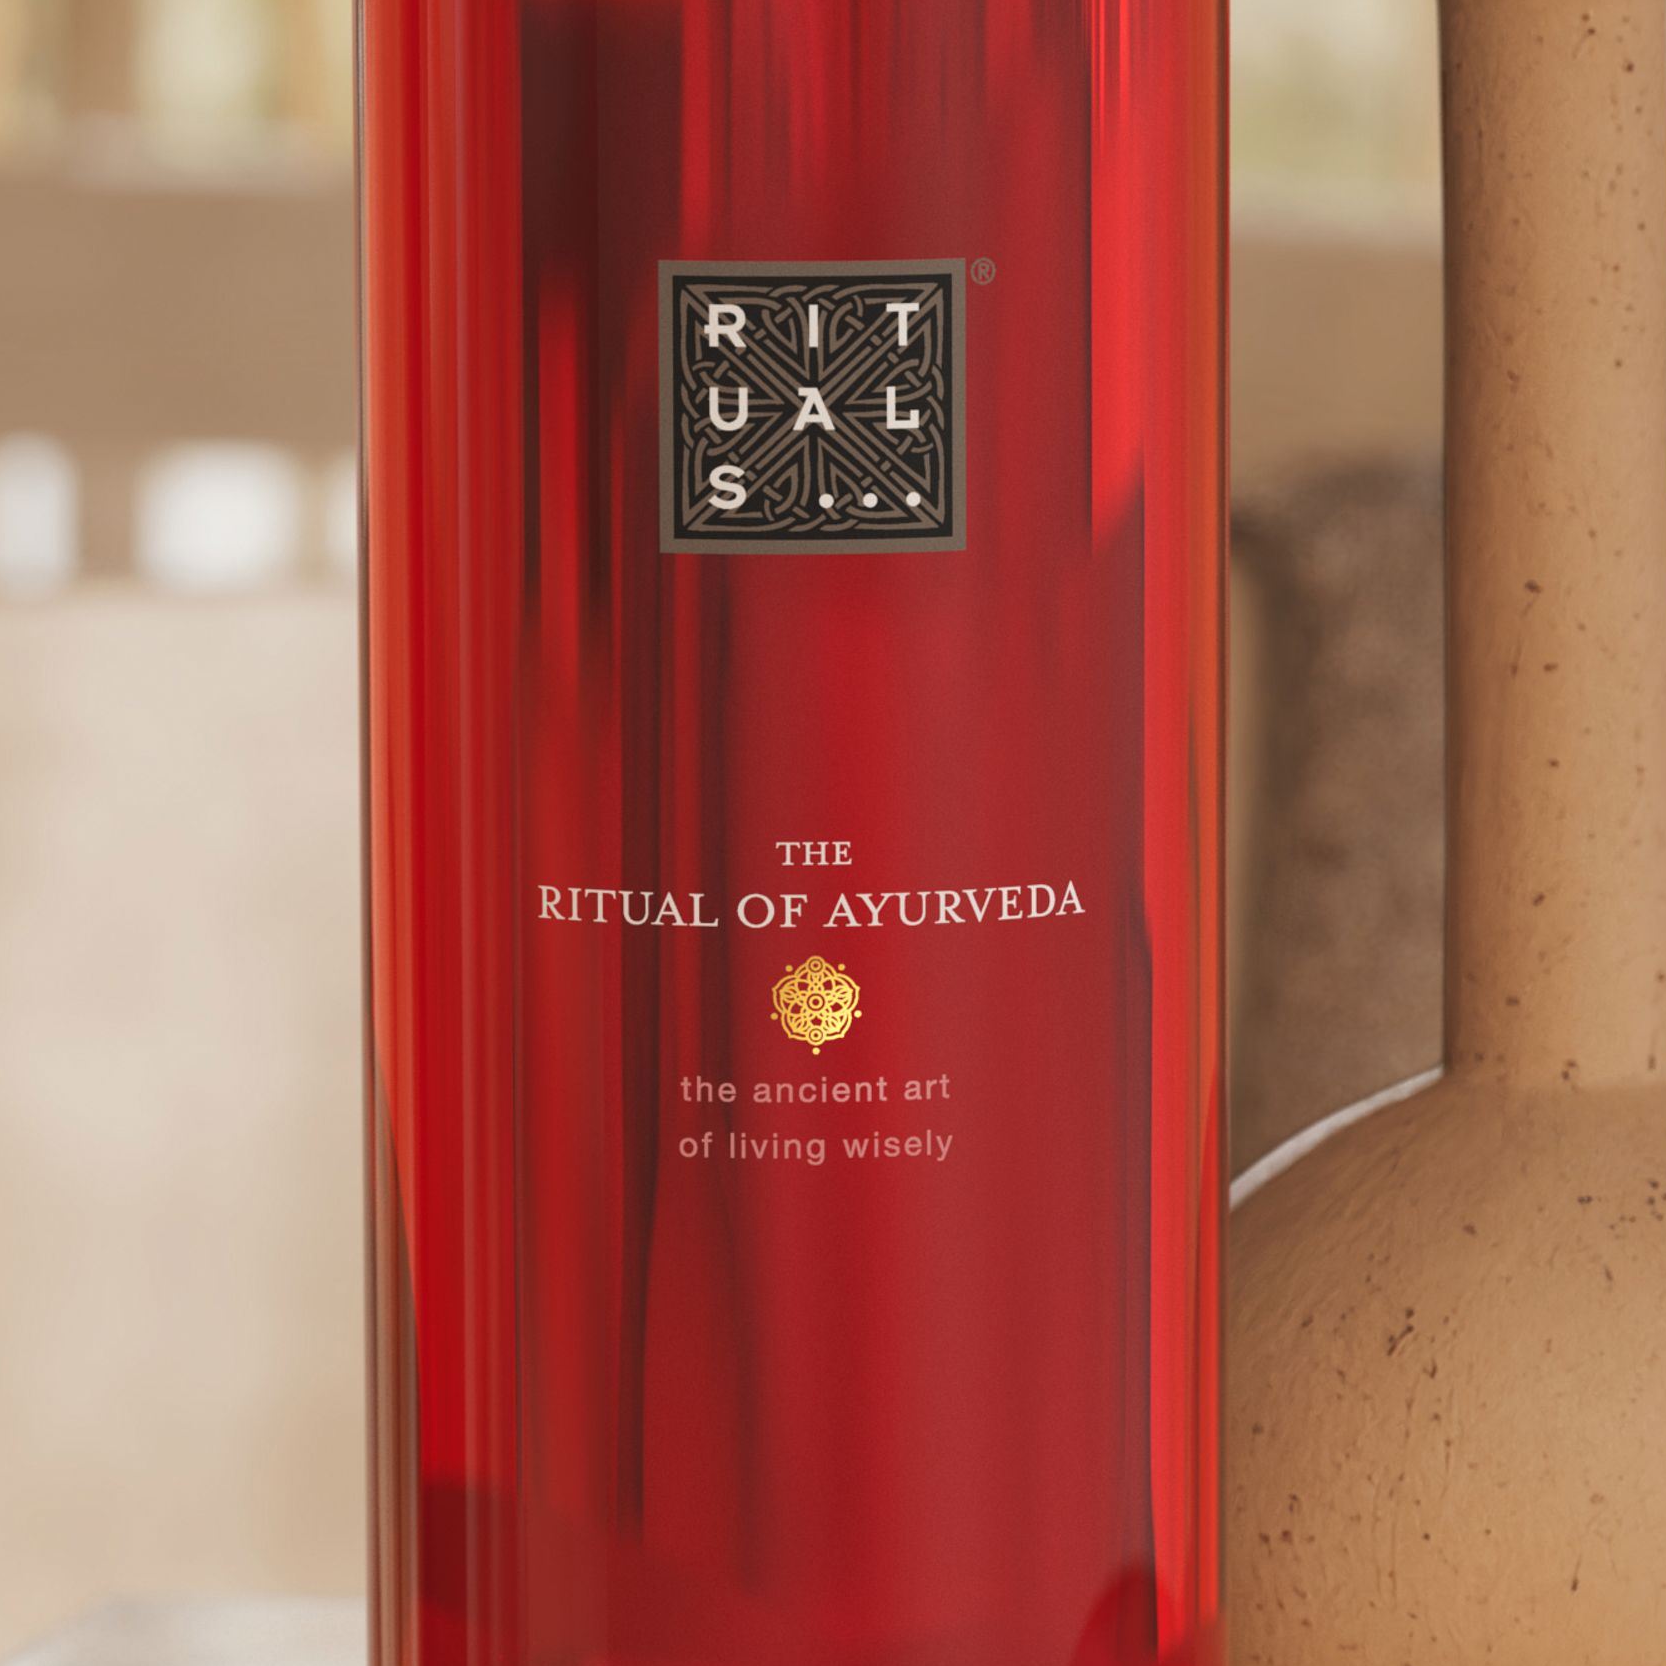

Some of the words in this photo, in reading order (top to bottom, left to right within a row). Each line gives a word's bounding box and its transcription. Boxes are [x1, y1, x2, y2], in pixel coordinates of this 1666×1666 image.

[704, 303, 920, 348] RIT
[708, 386, 920, 431] UAL
[776, 841, 853, 867] THE
[537, 885, 719, 927] RITUAL
[737, 893, 808, 928] OF
[823, 880, 1086, 928] AYURVEDA
[680, 1076, 737, 1102] the
[753, 1077, 888, 1103] ancient
[903, 1073, 951, 1100] art
[679, 1132, 713, 1158] of
[729, 1132, 826, 1165] living
[843, 1129, 953, 1162] wisely
